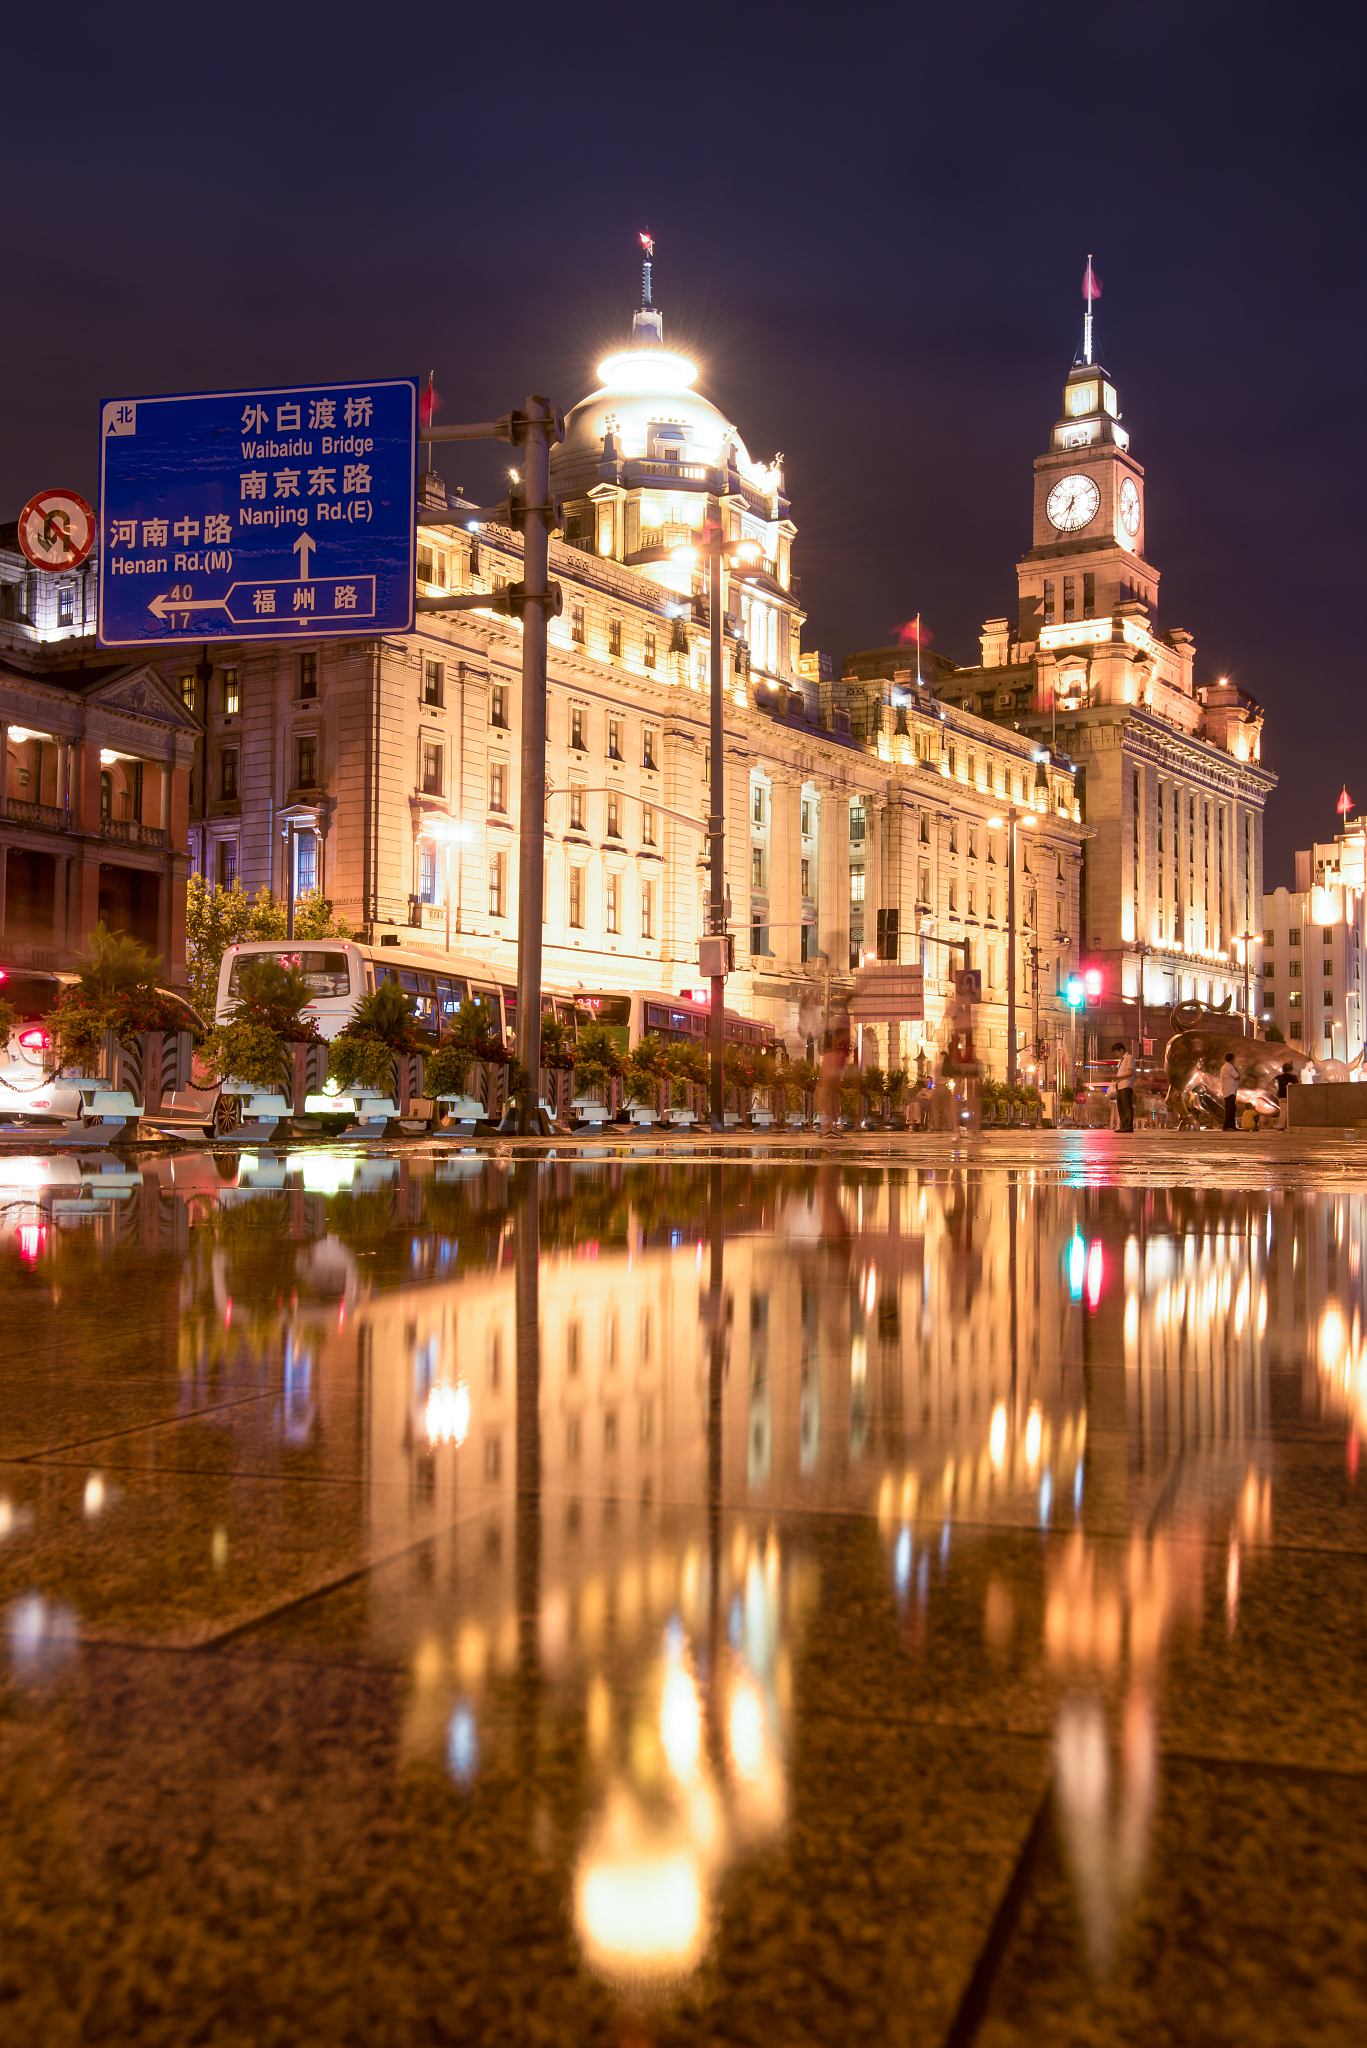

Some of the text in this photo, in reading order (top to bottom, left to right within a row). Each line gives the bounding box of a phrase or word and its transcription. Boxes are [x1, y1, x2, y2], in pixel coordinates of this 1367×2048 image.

[116, 406, 133, 424] 北
[241, 396, 374, 434] 外白渡桥
[241, 435, 374, 460] Waibaidu Bridge
[240, 463, 373, 500] 南京东路
[240, 500, 373, 528] Nanjing Rd.(E)
[110, 513, 233, 549] 河南中路
[111, 551, 233, 576] Henan Rd.(M)
[170, 584, 193, 601] 40
[253, 585, 358, 613] 福州路
[169, 612, 190, 629] 17
